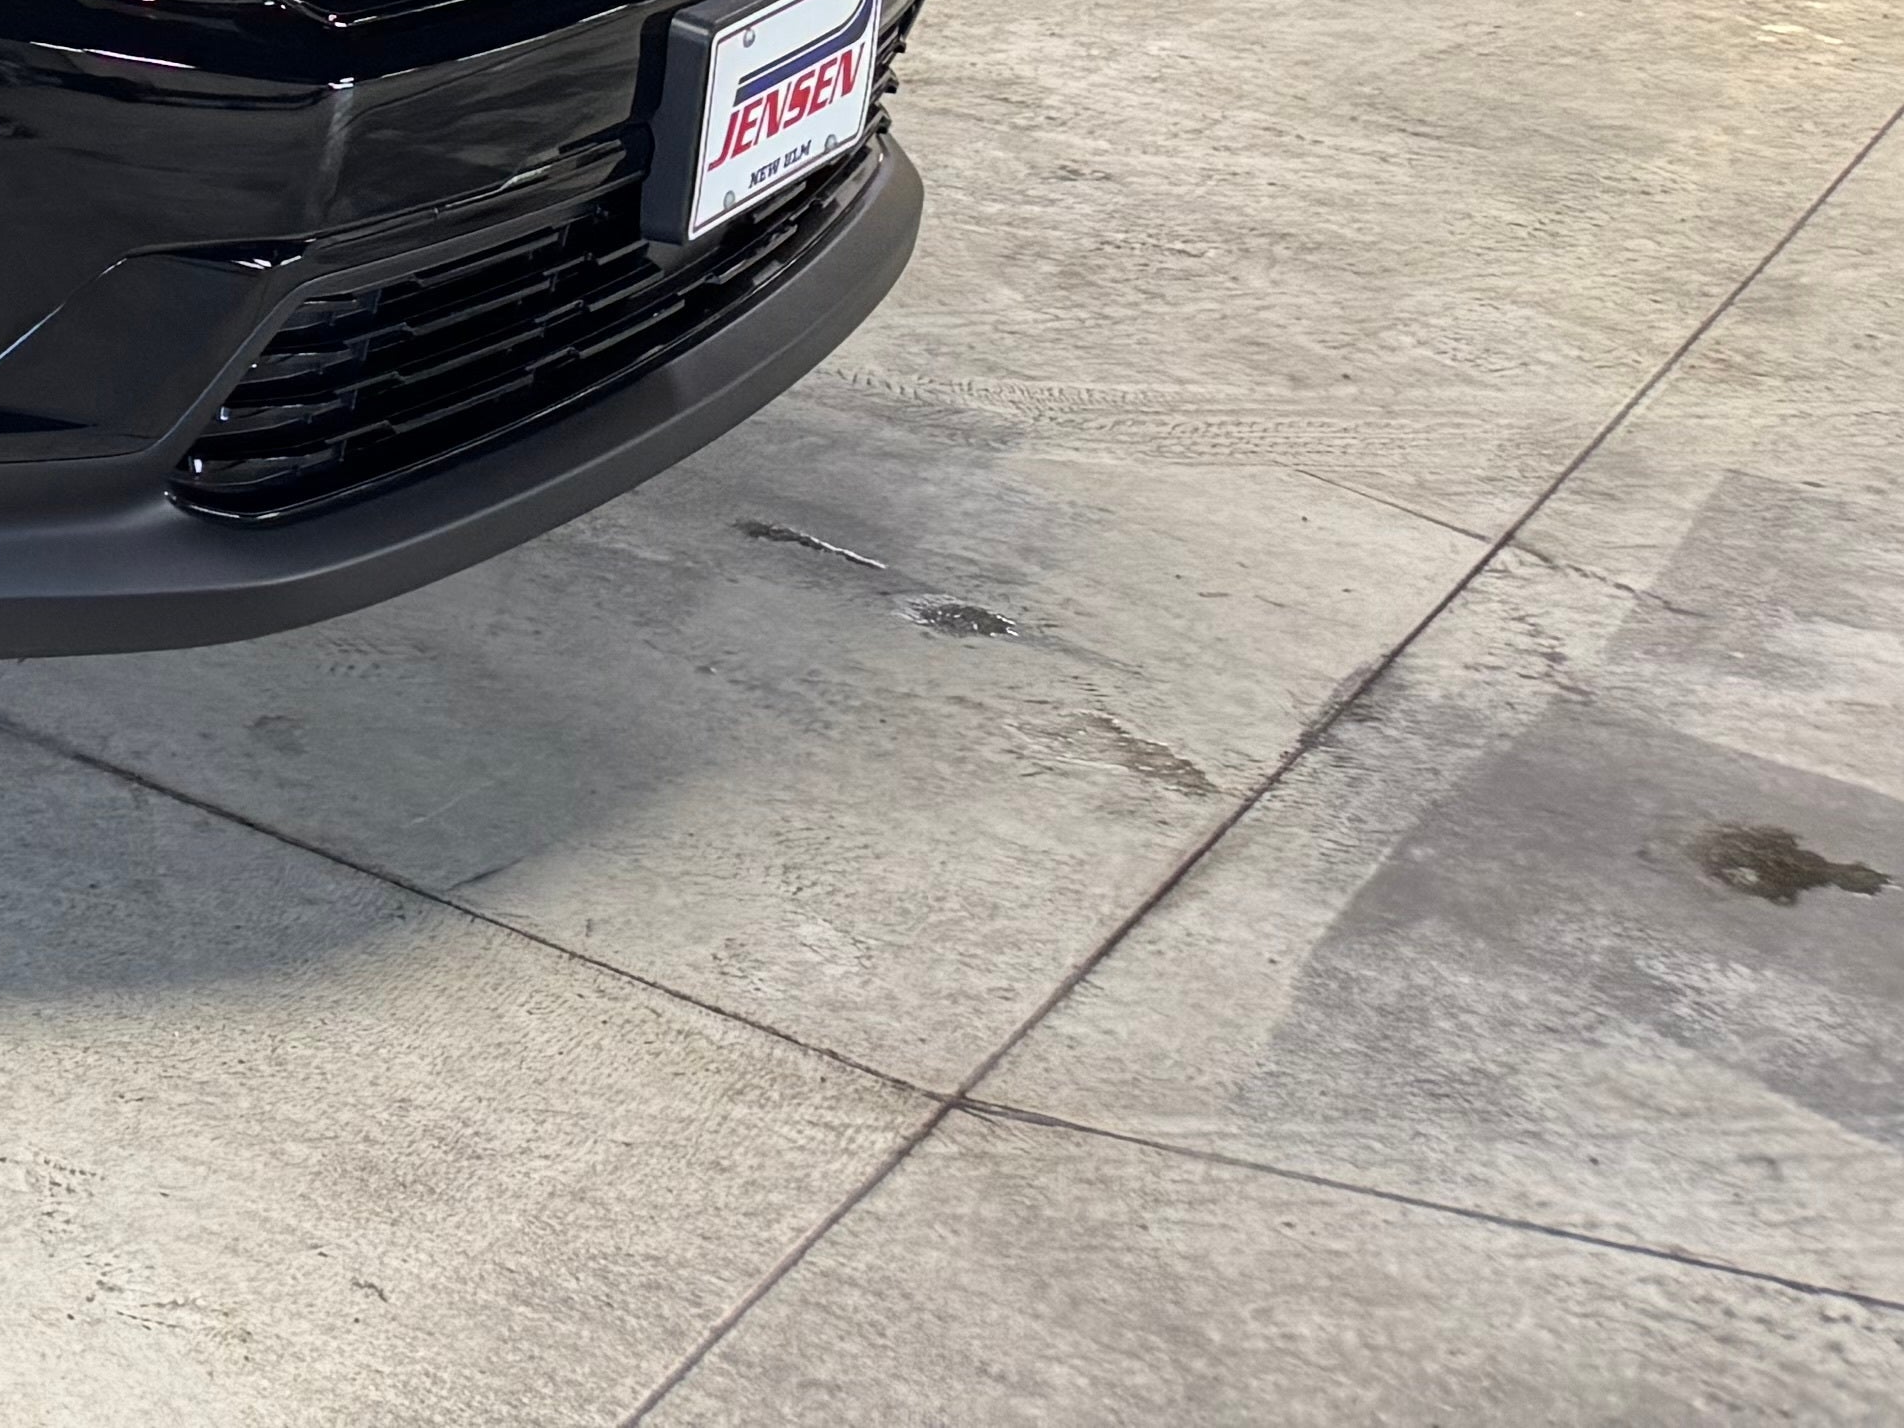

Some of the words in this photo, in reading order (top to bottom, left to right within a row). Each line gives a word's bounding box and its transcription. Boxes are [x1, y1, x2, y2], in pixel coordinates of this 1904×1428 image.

[707, 41, 866, 173] JENSEN
[748, 157, 781, 189] NEW
[783, 139, 812, 169] ULM
